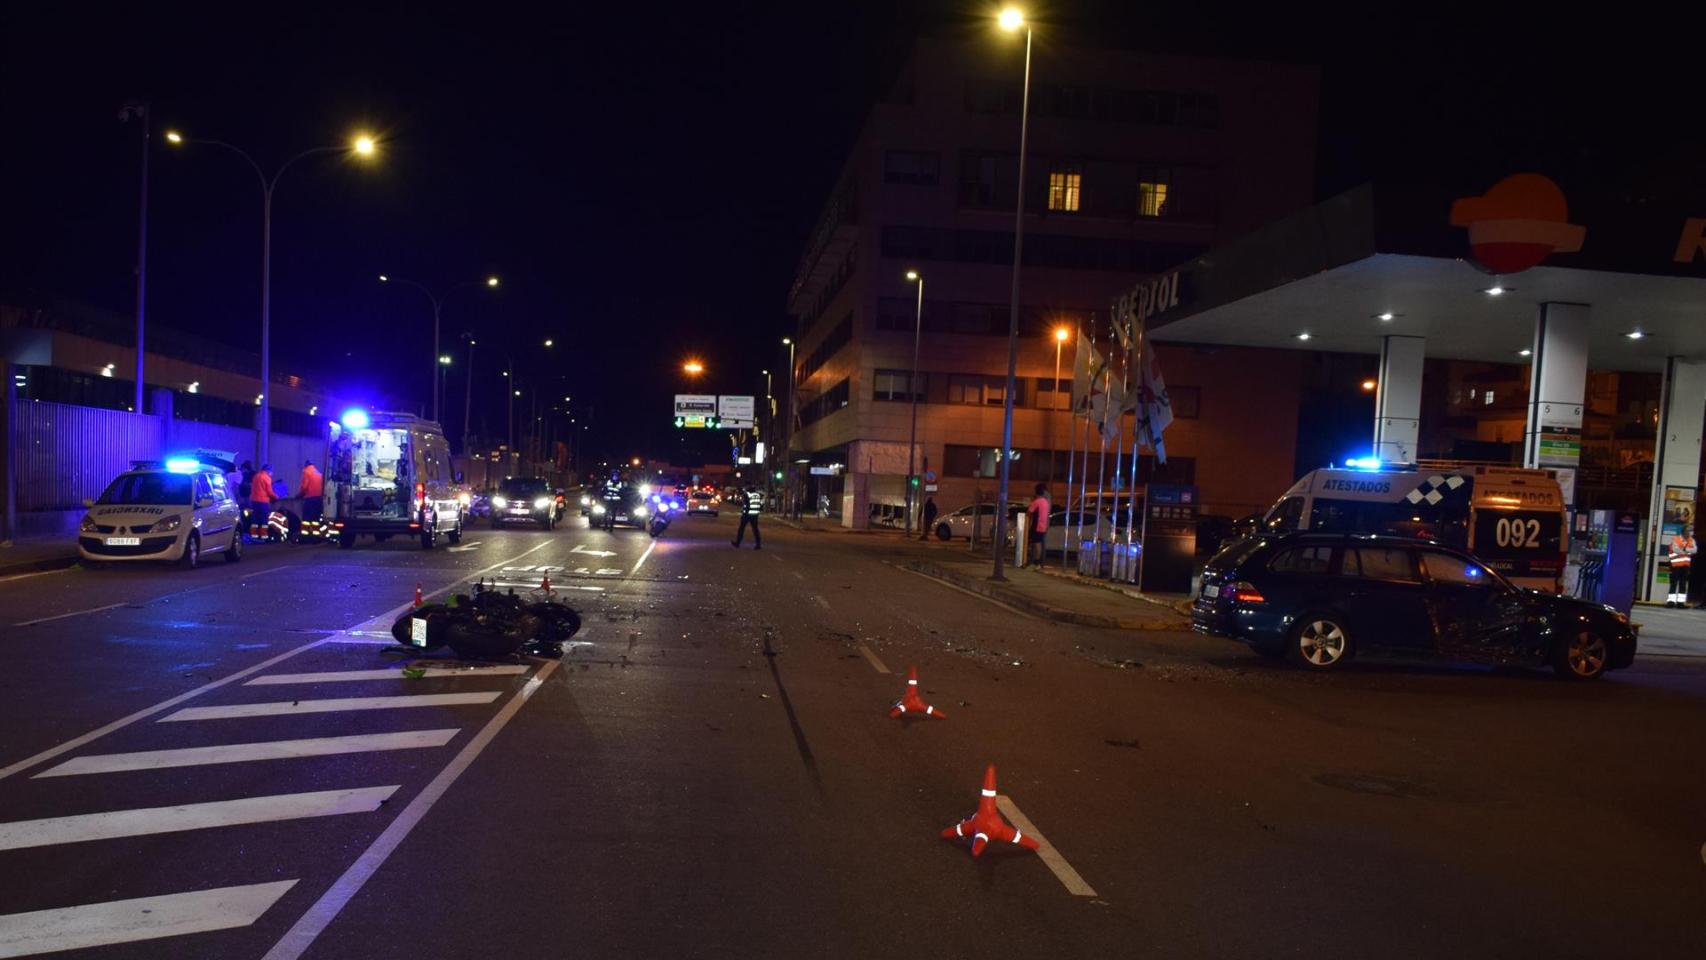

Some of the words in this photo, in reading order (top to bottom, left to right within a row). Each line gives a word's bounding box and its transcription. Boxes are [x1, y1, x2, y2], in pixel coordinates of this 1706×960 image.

[1544, 405, 1551, 414] 5
[1574, 407, 1581, 416] 6
[1322, 479, 1391, 494] ATESTADOS
[1495, 517, 1541, 549] 092
